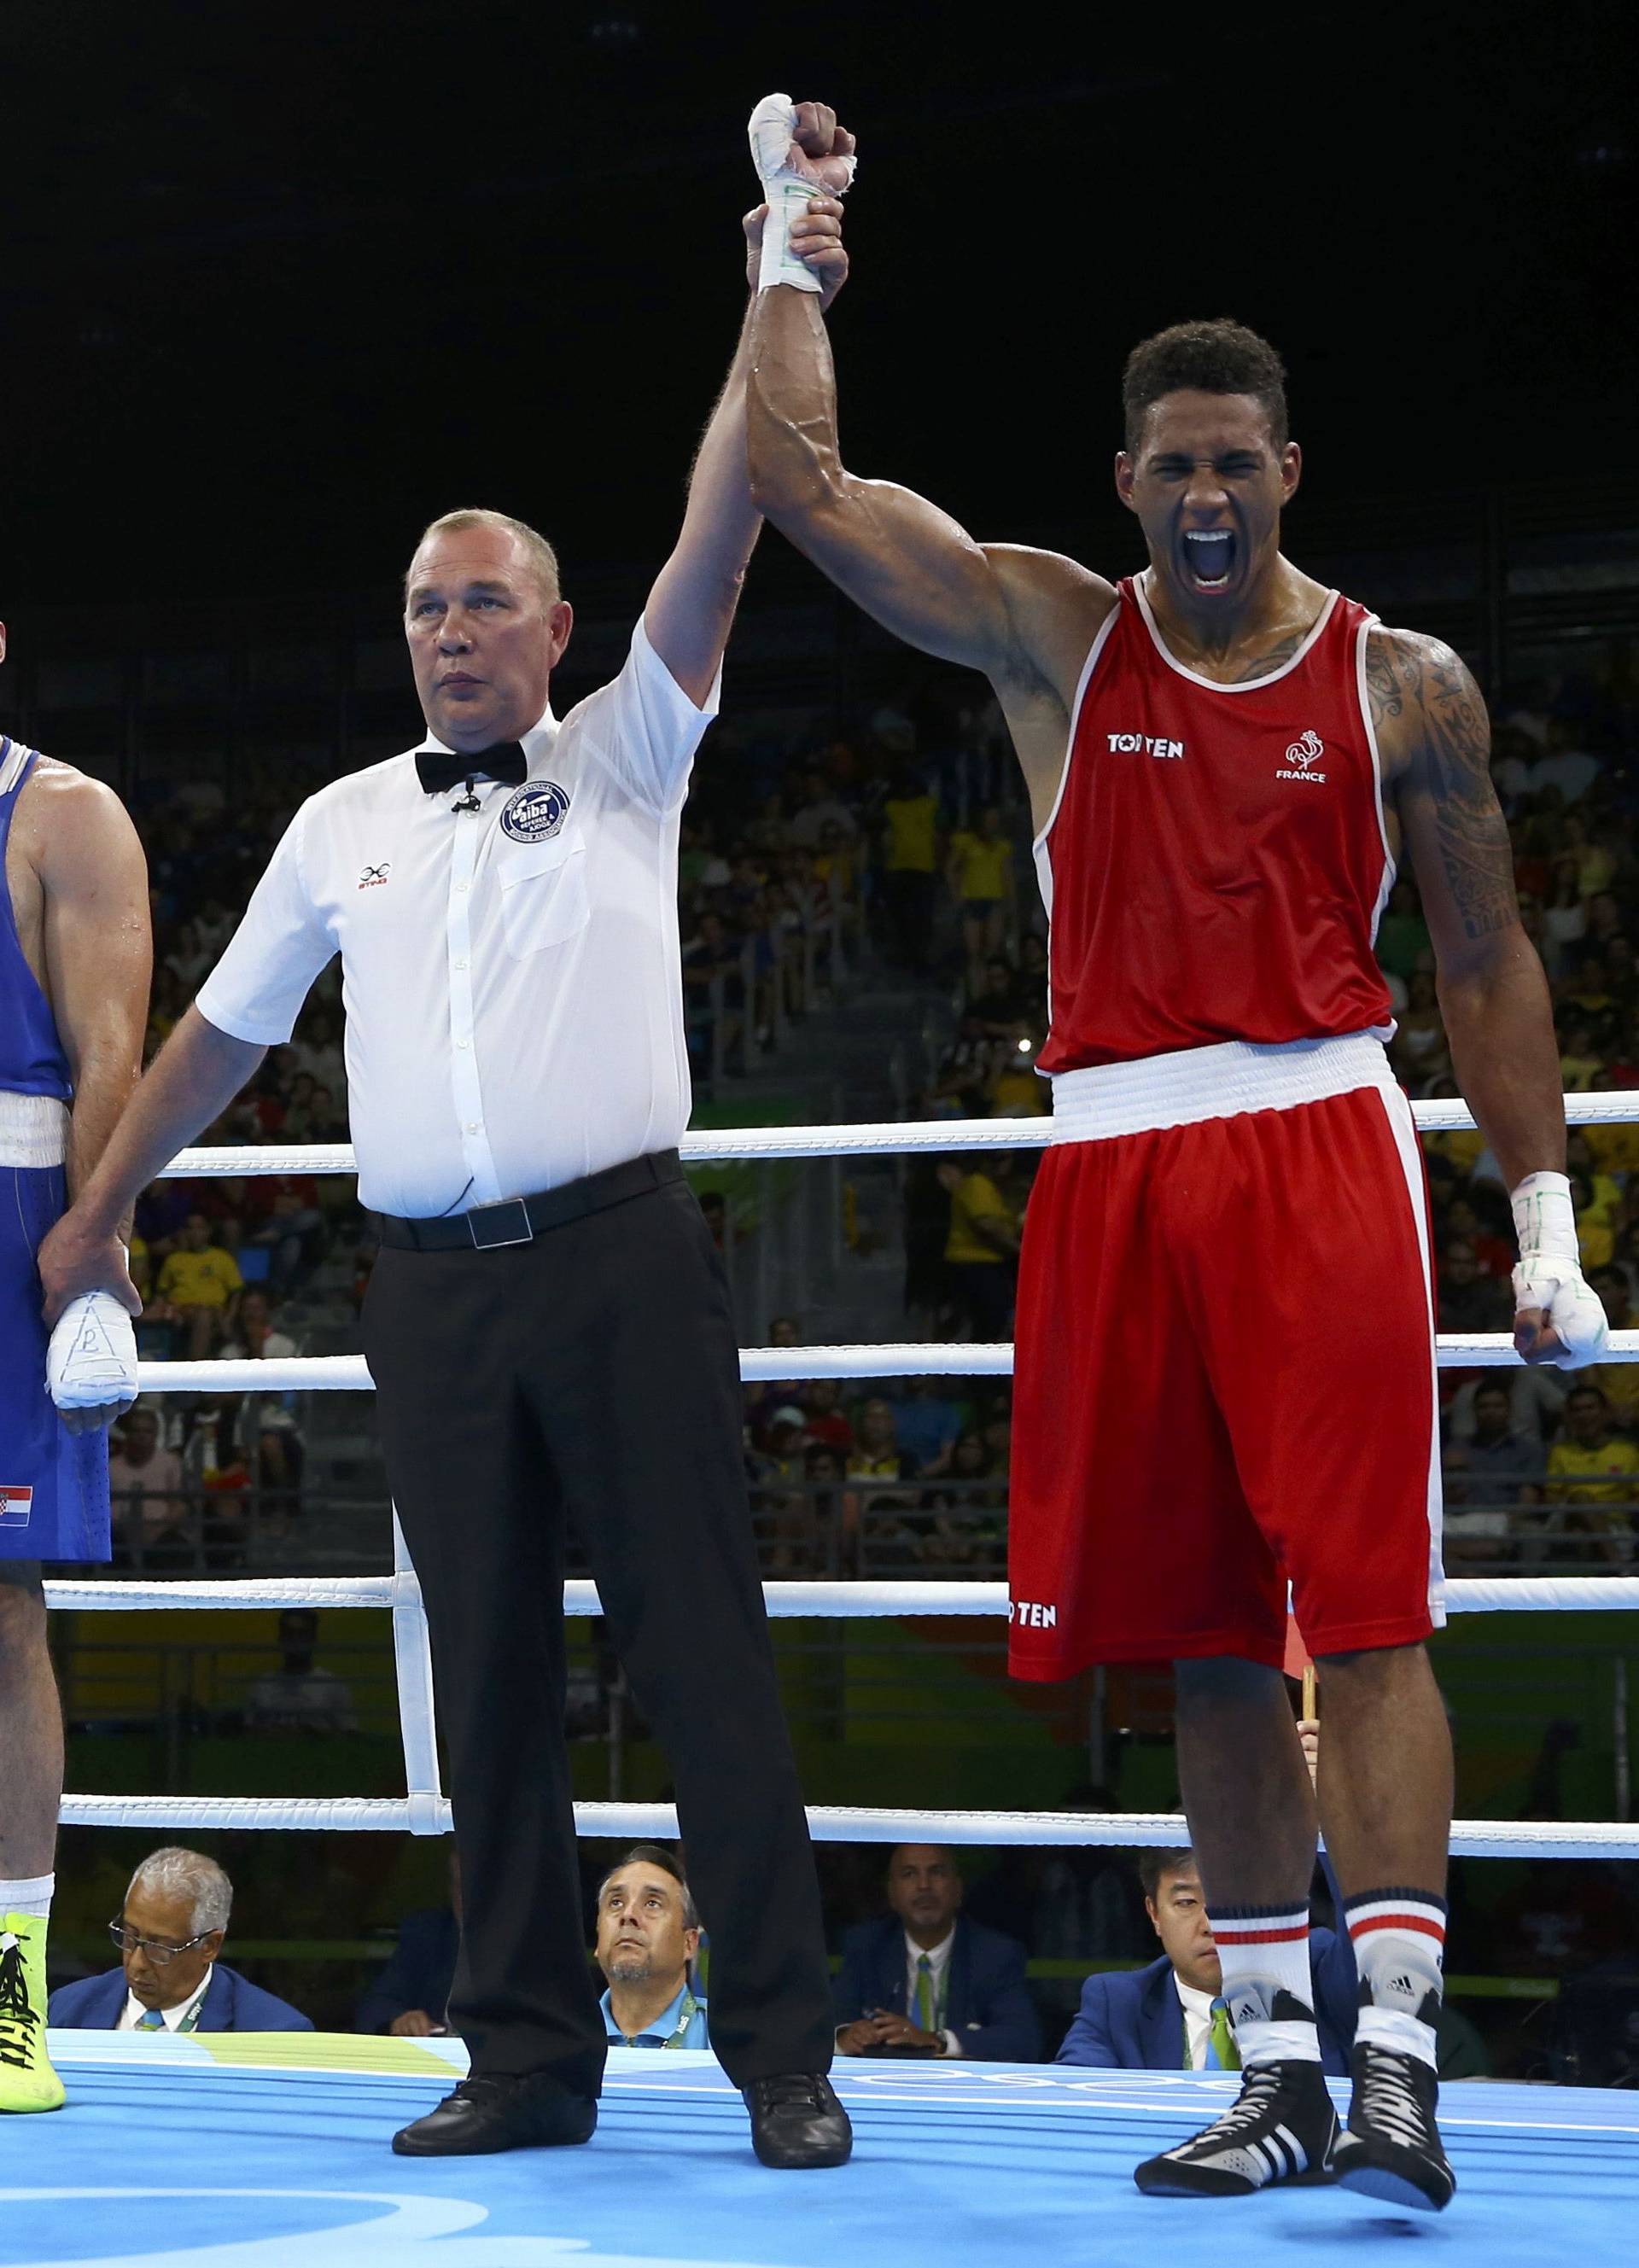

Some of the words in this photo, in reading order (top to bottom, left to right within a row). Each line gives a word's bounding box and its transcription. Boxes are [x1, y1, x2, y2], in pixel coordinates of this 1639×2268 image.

[1275, 770, 1327, 784] FRANCE
[519, 803, 548, 823] aiba
[1018, 1601, 1057, 1629] TEN
